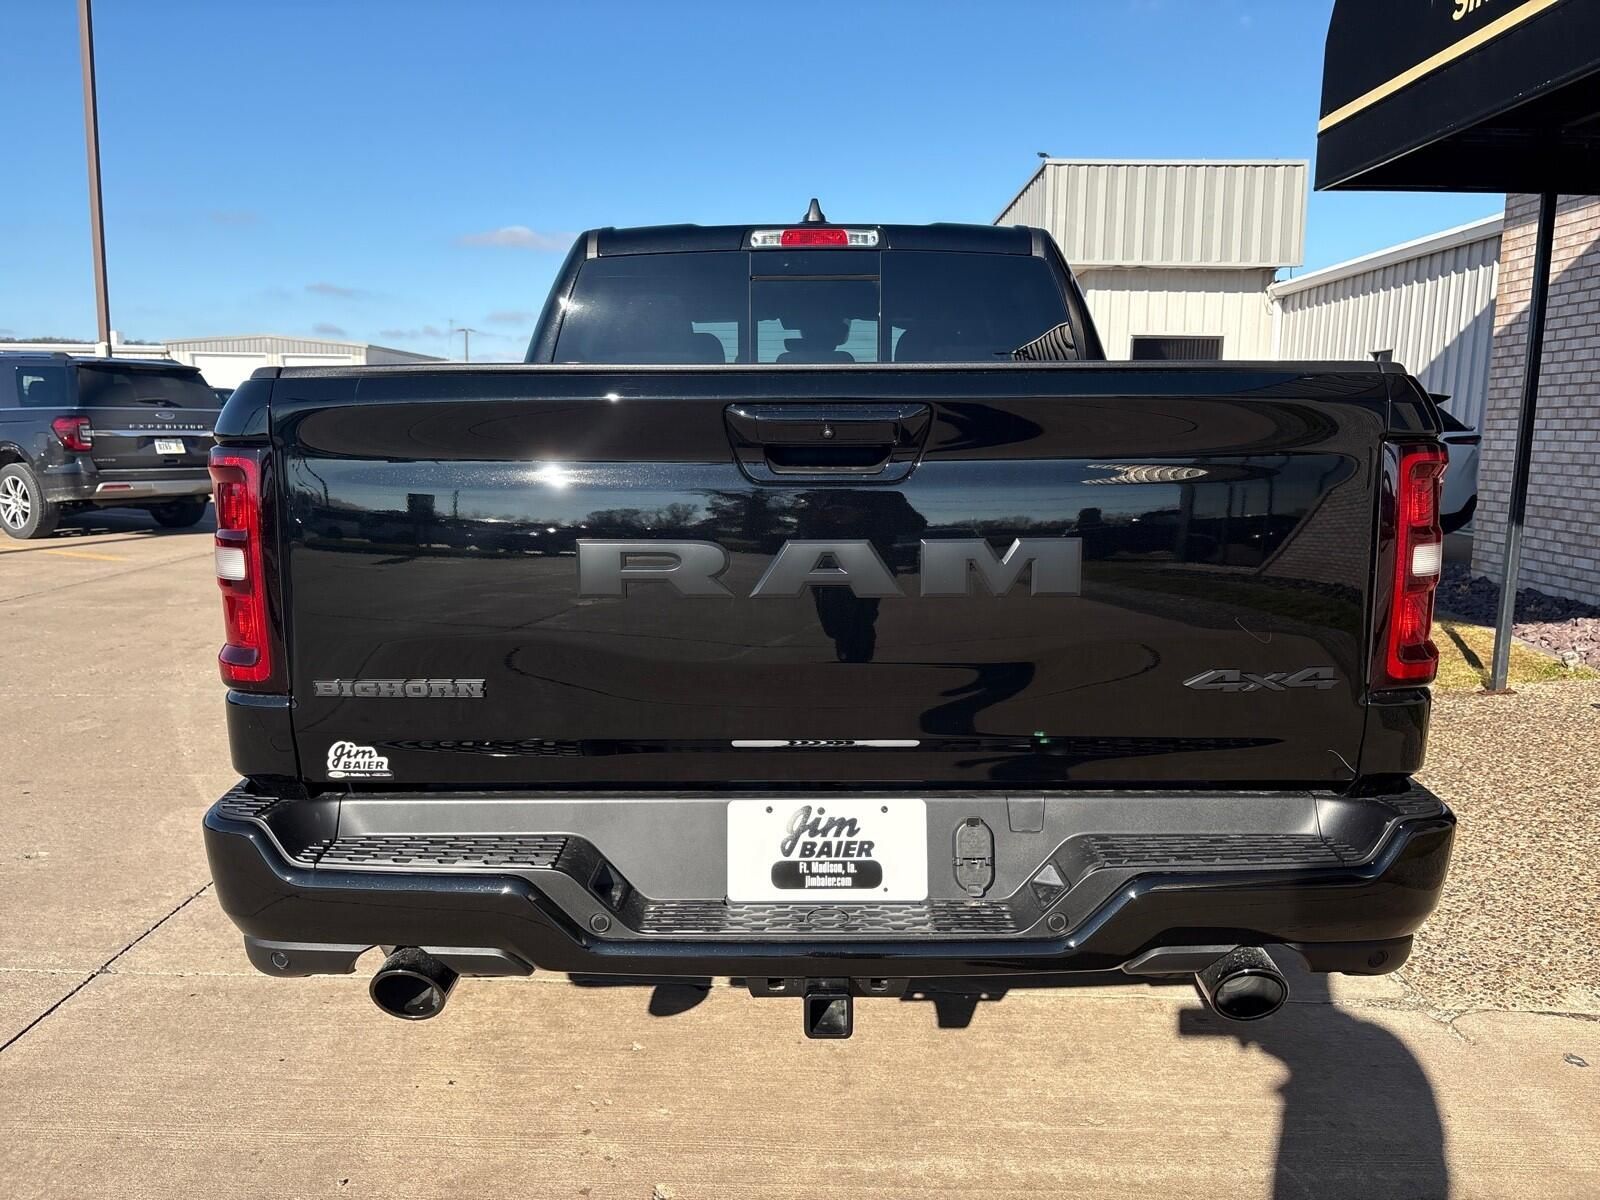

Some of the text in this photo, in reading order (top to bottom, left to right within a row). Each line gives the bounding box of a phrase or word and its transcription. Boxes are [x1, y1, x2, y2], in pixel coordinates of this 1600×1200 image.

[576, 538, 1082, 598] RAM
[312, 679, 488, 698] BIGHORN
[331, 743, 376, 768] Jim
[343, 760, 385, 770] BAIER
[780, 804, 861, 858] Jim
[798, 840, 875, 859] BAIER
[799, 861, 810, 874] Ft.
[811, 861, 846, 875] Madison,
[804, 875, 853, 889] jimbaier.com
